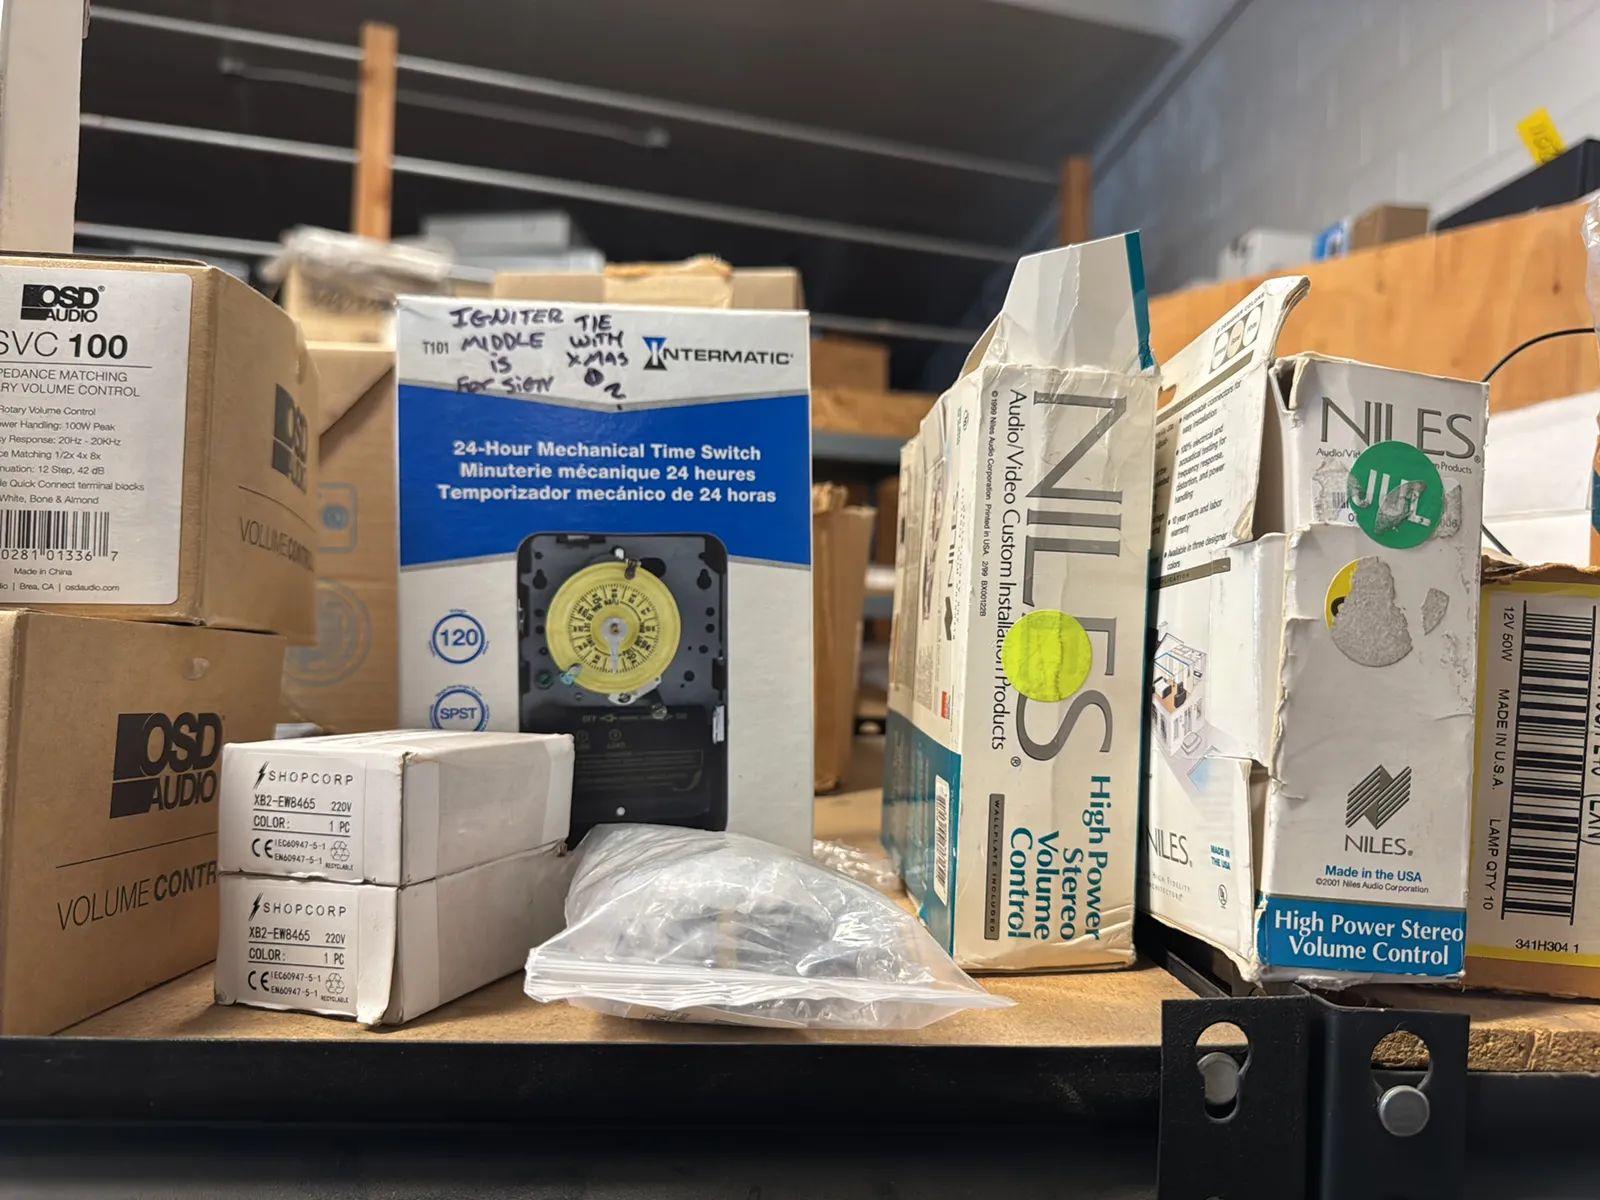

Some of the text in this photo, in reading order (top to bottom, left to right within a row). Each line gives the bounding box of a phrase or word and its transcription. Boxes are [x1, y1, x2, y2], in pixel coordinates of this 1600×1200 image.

[41, 285, 99, 309] OSD
[46, 309, 98, 322] AUDIO
[449, 306, 565, 329] IGNITER
[574, 314, 613, 332] TIE
[69, 333, 128, 359] 100
[423, 341, 449, 355] T101
[461, 331, 546, 351] MIDDLE
[0, 368, 127, 382] EDANCE MATCHING
[21, 383, 140, 397] VOLUME CONTROL
[29, 406, 61, 415] Volume
[63, 407, 96, 416] Control
[20, 421, 116, 432] Handling: 100W Peak
[989, 416, 997, 435] Niles
[1213, 423, 1224, 436] and
[9, 435, 56, 446] Response:
[58, 436, 82, 445] 20Hz
[988, 436, 996, 458] Audio
[1003, 389, 1027, 505] Audio/Video
[1201, 440, 1219, 455] testing
[11, 450, 52, 460] Matching
[76, 452, 87, 460] 4x
[90, 452, 101, 460] 8x
[453, 440, 762, 461] 24-Hour Mechanical Time Switch
[38, 465, 49, 473] 12
[51, 465, 75, 475] Step,
[91, 467, 105, 475] dB
[459, 462, 756, 483] Minuterie mécanique 24 heures
[1208, 463, 1226, 479] power
[1441, 462, 1472, 475] Products
[9, 479, 145, 491] Quick Connect terminal blocks
[985, 458, 995, 500] Corporation
[30, 495, 53, 503] Bone
[65, 495, 99, 504] Almond
[436, 483, 777, 503] Temporizador mecánico de 24 horas
[1174, 490, 1194, 504] handling
[984, 504, 992, 529] Printed
[1177, 513, 1186, 525] year
[1187, 508, 1199, 521] parts
[1200, 504, 1208, 514] and
[1209, 499, 1223, 511] labor
[1171, 525, 1190, 538] warranty
[999, 509, 1021, 577] Custom
[1168, 532, 1228, 558] Available three designer
[111, 551, 119, 561] 7
[13, 567, 72, 576] Made in China
[981, 560, 989, 577] 2/99
[1167, 560, 1180, 571] colors
[42, 583, 55, 591] CA
[65, 583, 120, 593] osdaudio.com
[440, 628, 479, 646] 120
[440, 707, 478, 720] SPST
[991, 675, 1012, 750] Products
[140, 712, 223, 777] OSD
[1483, 607, 1515, 911] 12V 50W MADE IN U.S.A. LAMP QTY 10
[269, 769, 354, 786] SHOPCORP
[149, 769, 218, 811] AUDIO
[254, 793, 353, 814] XB2-EW8465 220V
[253, 815, 351, 833] COLOR: PC
[1210, 844, 1224, 857] MADE
[1344, 834, 1407, 856] NILES
[989, 799, 1001, 932] WALLPLATE INCLUDED
[1082, 775, 1111, 940] High Power
[1211, 856, 1232, 871] THE USA
[1325, 865, 1422, 882] Made in the USA
[1007, 827, 1034, 939] Control
[1034, 830, 1060, 940] Volume
[1343, 880, 1361, 889] Niles
[1362, 881, 1384, 890] Audio
[1385, 883, 1429, 894] Corporation
[1059, 847, 1084, 941] Stereo
[57, 878, 151, 931] VOLUME
[263, 902, 347, 917] SHOPCORP
[1275, 909, 1464, 942] High Power Stereo
[249, 925, 346, 945] XB2-EW8465 220V
[1289, 936, 1449, 966] Volume Control
[1515, 939, 1579, 953] 341H304 1
[249, 947, 345, 966] COLOR: PC
